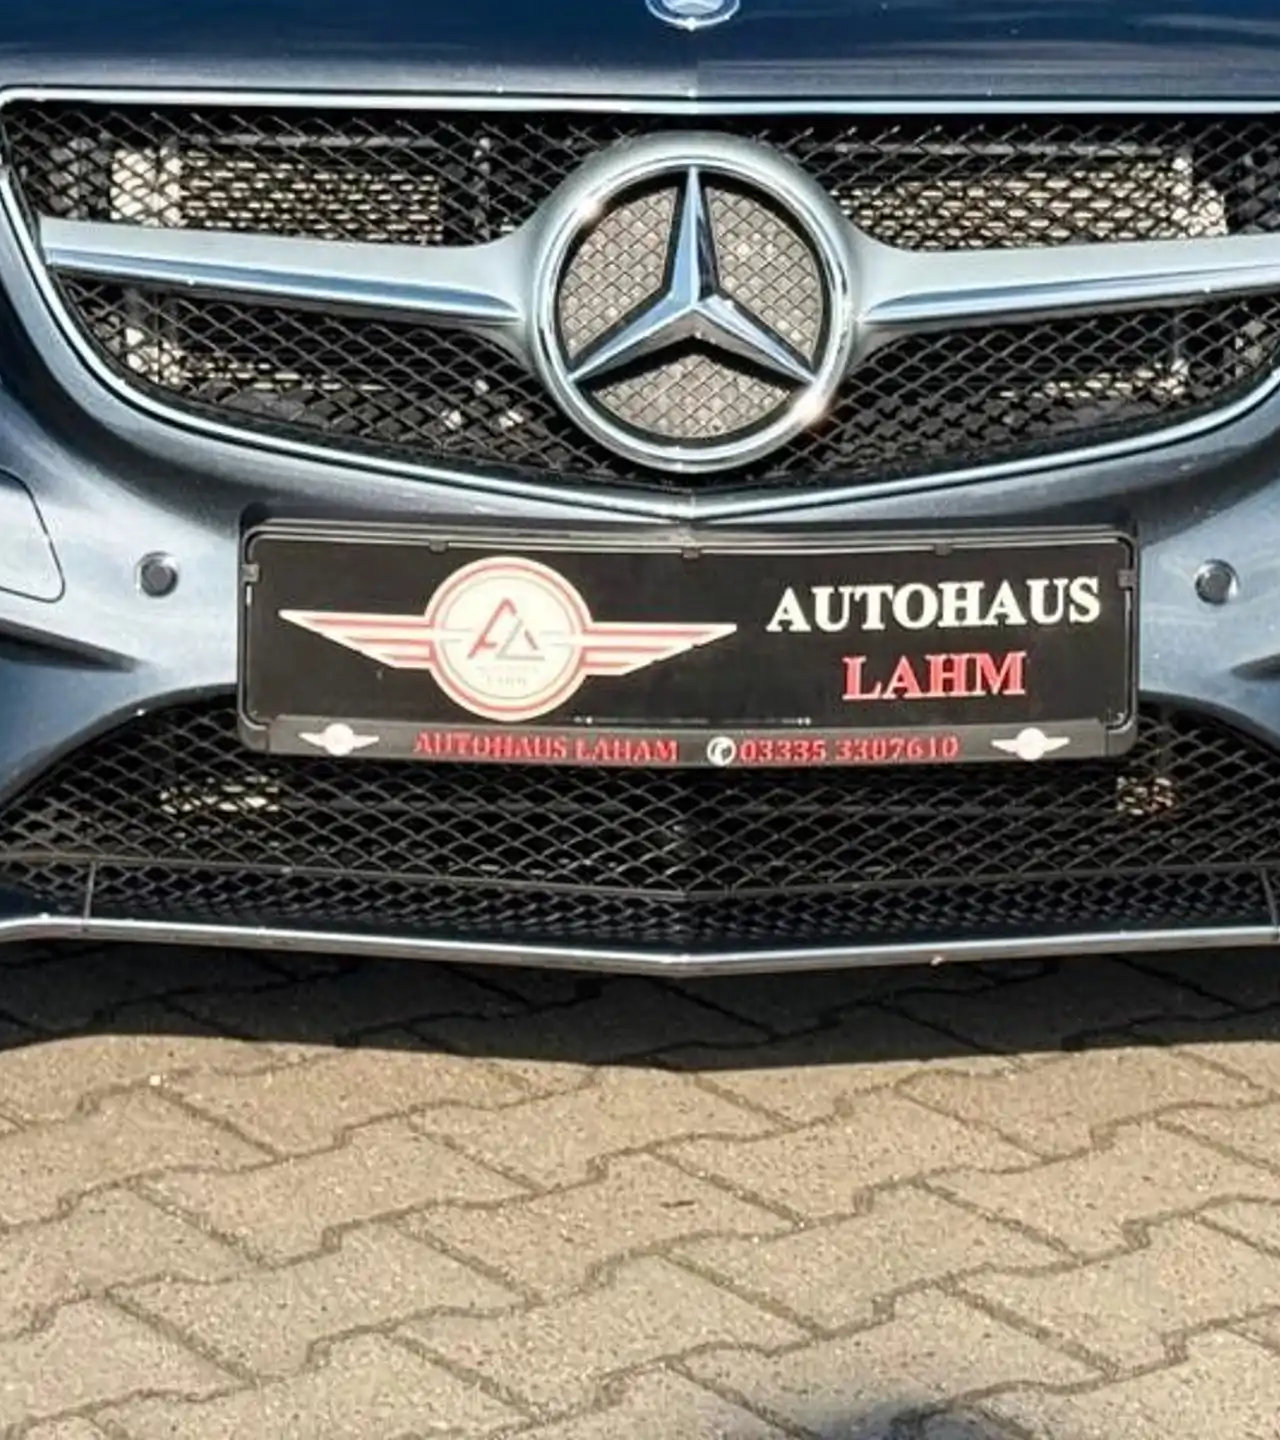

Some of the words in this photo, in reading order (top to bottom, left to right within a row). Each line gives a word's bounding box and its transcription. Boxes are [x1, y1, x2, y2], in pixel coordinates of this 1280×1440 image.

[765, 576, 1101, 633] AUTOHAUS
[842, 651, 1028, 700] LAHM
[414, 732, 568, 759] AUTOHAUS
[739, 738, 828, 763] 03335
[835, 736, 961, 760] 3307610
